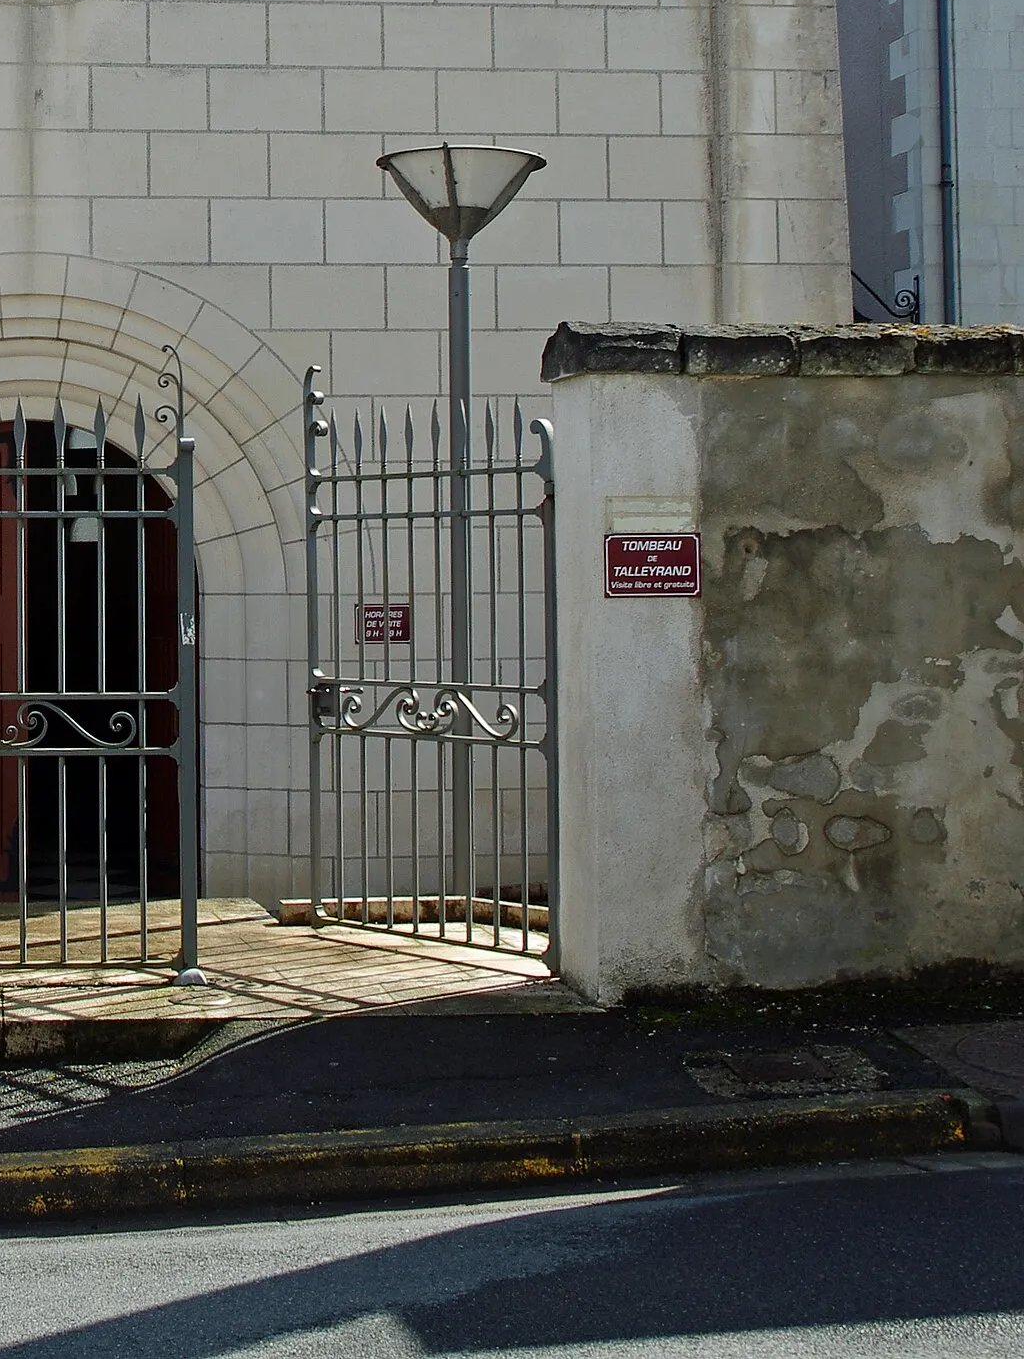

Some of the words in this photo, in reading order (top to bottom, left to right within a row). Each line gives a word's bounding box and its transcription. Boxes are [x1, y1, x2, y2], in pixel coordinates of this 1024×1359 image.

[622, 540, 682, 551] TOMBEAU
[613, 566, 691, 577] TALLEYRAND
[611, 581, 633, 589] Visite
[635, 581, 652, 589] libre
[664, 581, 695, 589] gratuite
[366, 620, 377, 628] DE
[378, 620, 402, 628] VITE
